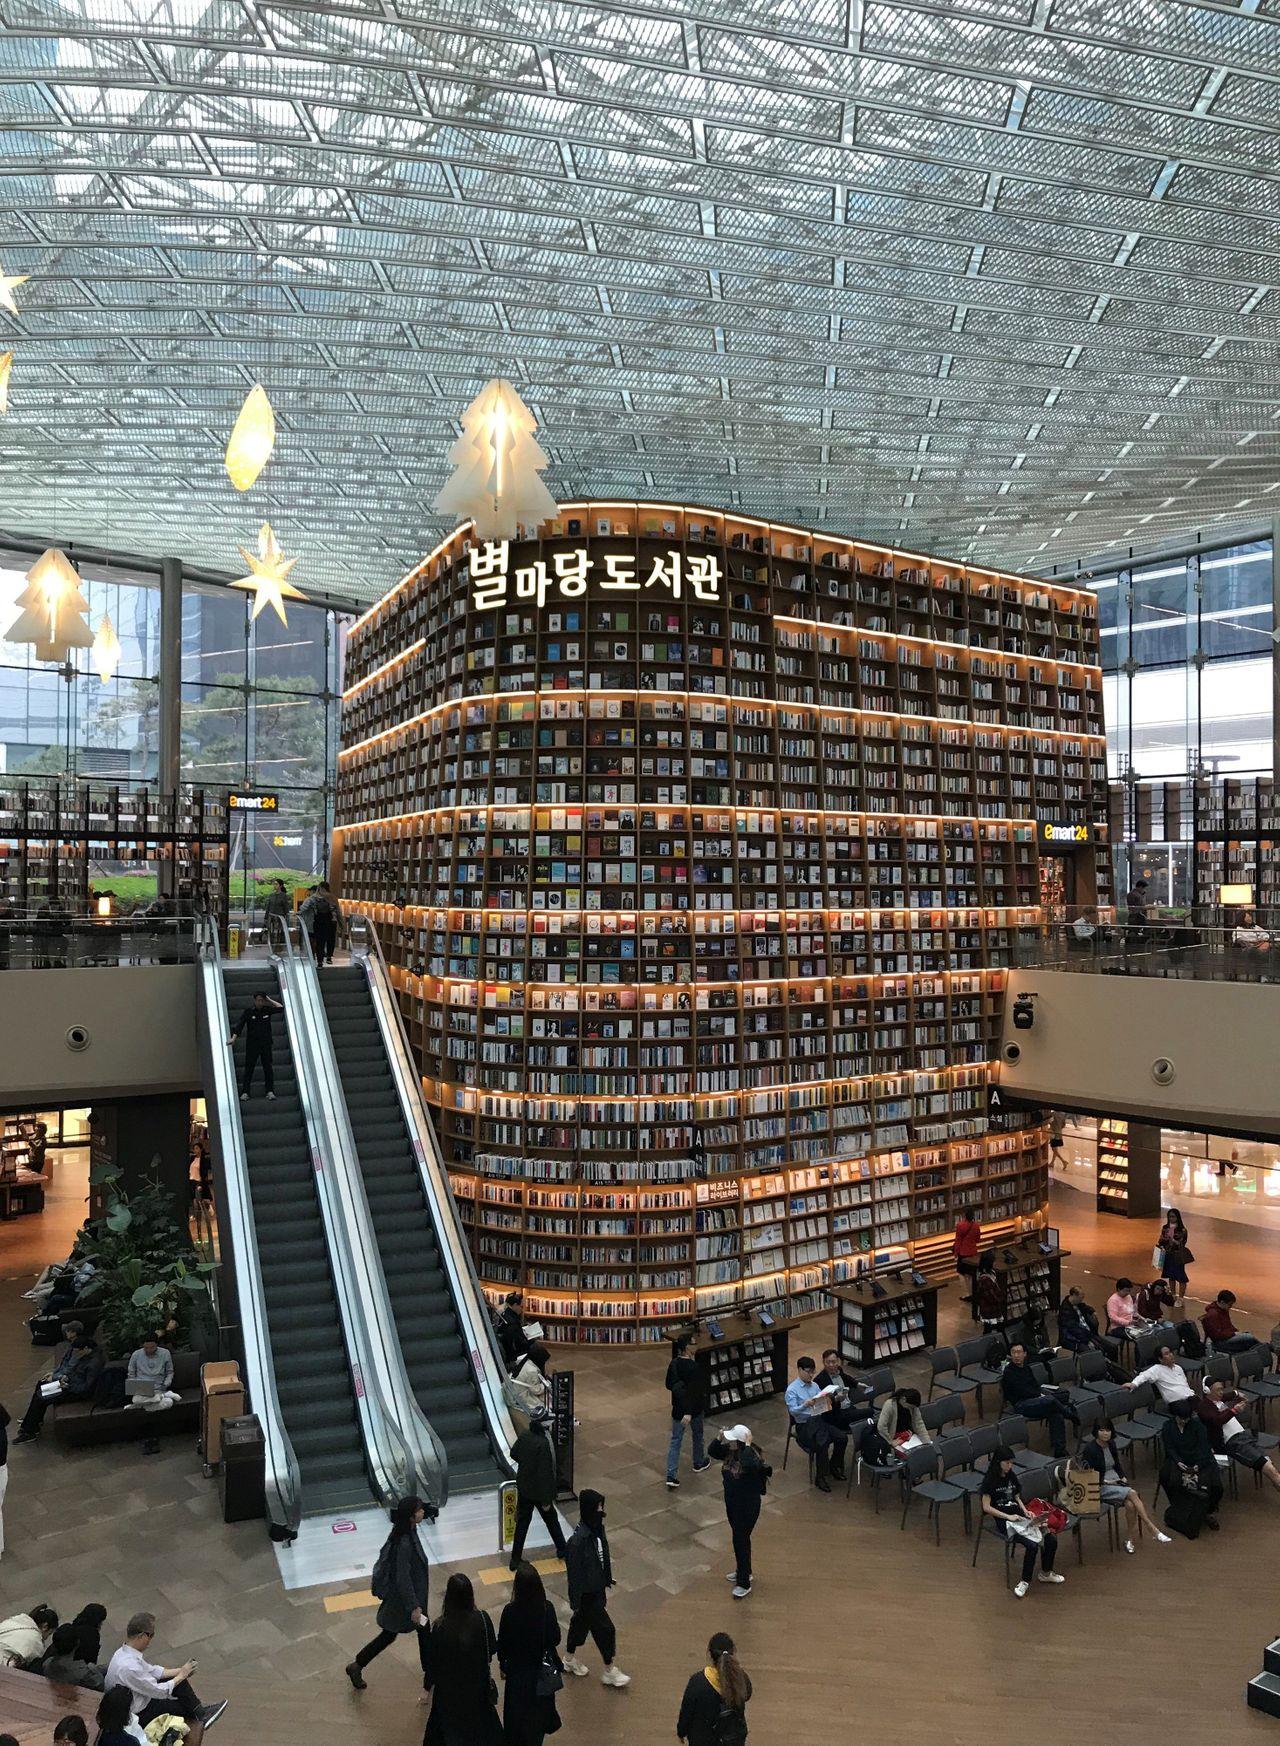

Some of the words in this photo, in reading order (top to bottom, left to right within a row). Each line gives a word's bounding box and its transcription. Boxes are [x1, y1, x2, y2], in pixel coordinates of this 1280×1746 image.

[468, 540, 594, 610] 별마당
[600, 550, 722, 600] 도서관
[1044, 823, 1088, 841] emart24
[990, 1090, 1001, 1105] A
[695, 1130, 702, 1147] A
[709, 1180, 738, 1192] 비즈니스
